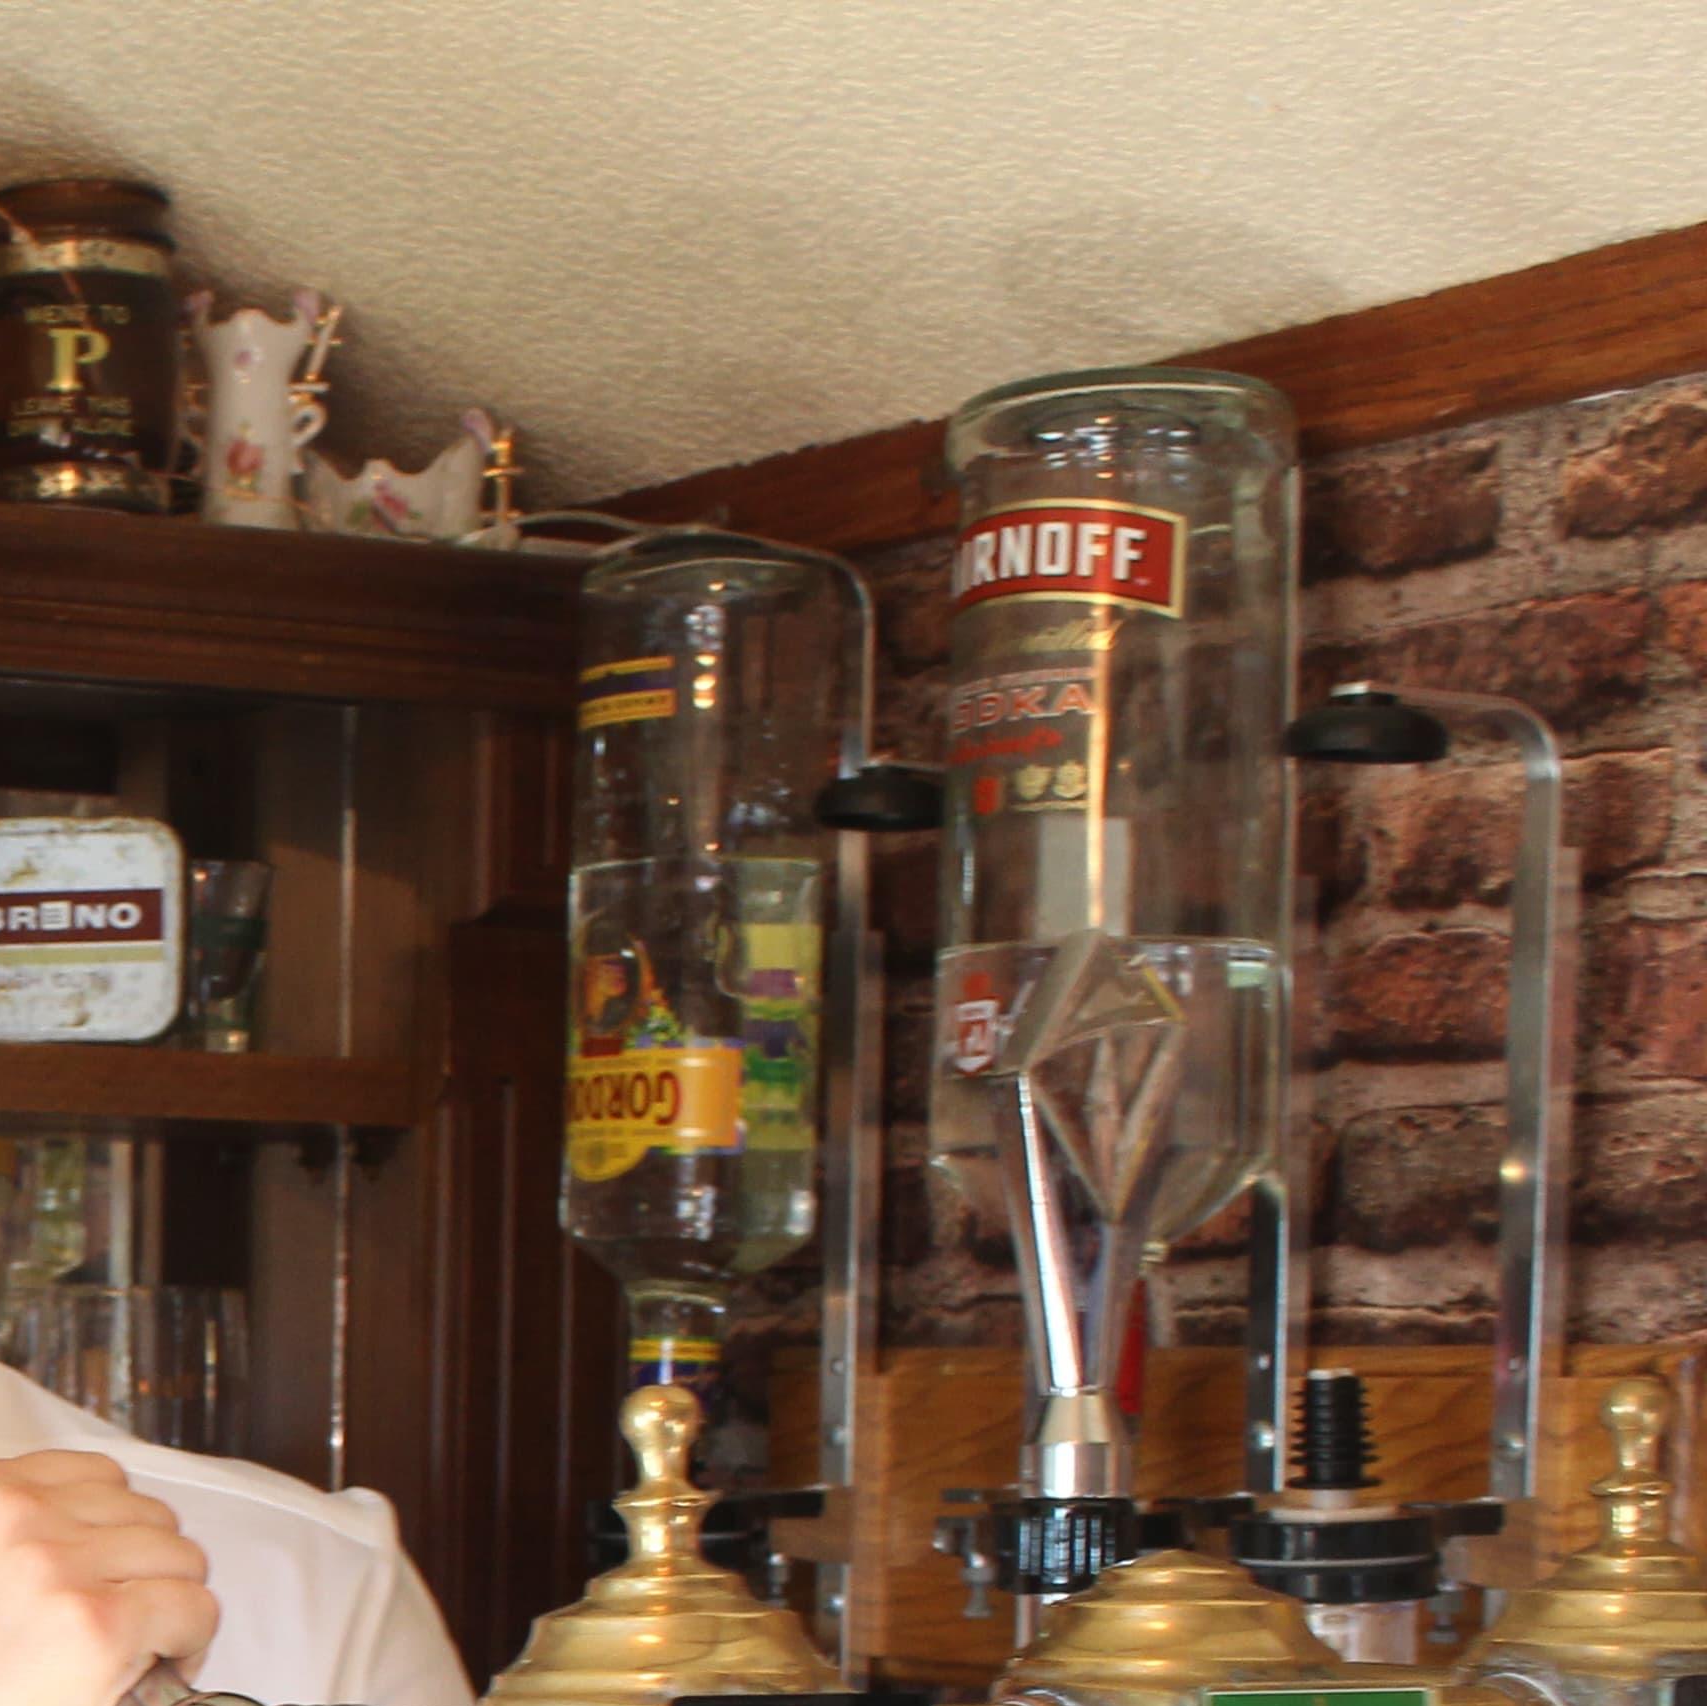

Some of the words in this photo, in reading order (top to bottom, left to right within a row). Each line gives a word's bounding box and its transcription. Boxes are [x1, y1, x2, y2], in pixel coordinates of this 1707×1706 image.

[47, 327, 110, 392] P
[952, 521, 1148, 598] IRNOFF
[950, 682, 1097, 737] ODKA
[567, 1070, 684, 1128] GORDO
